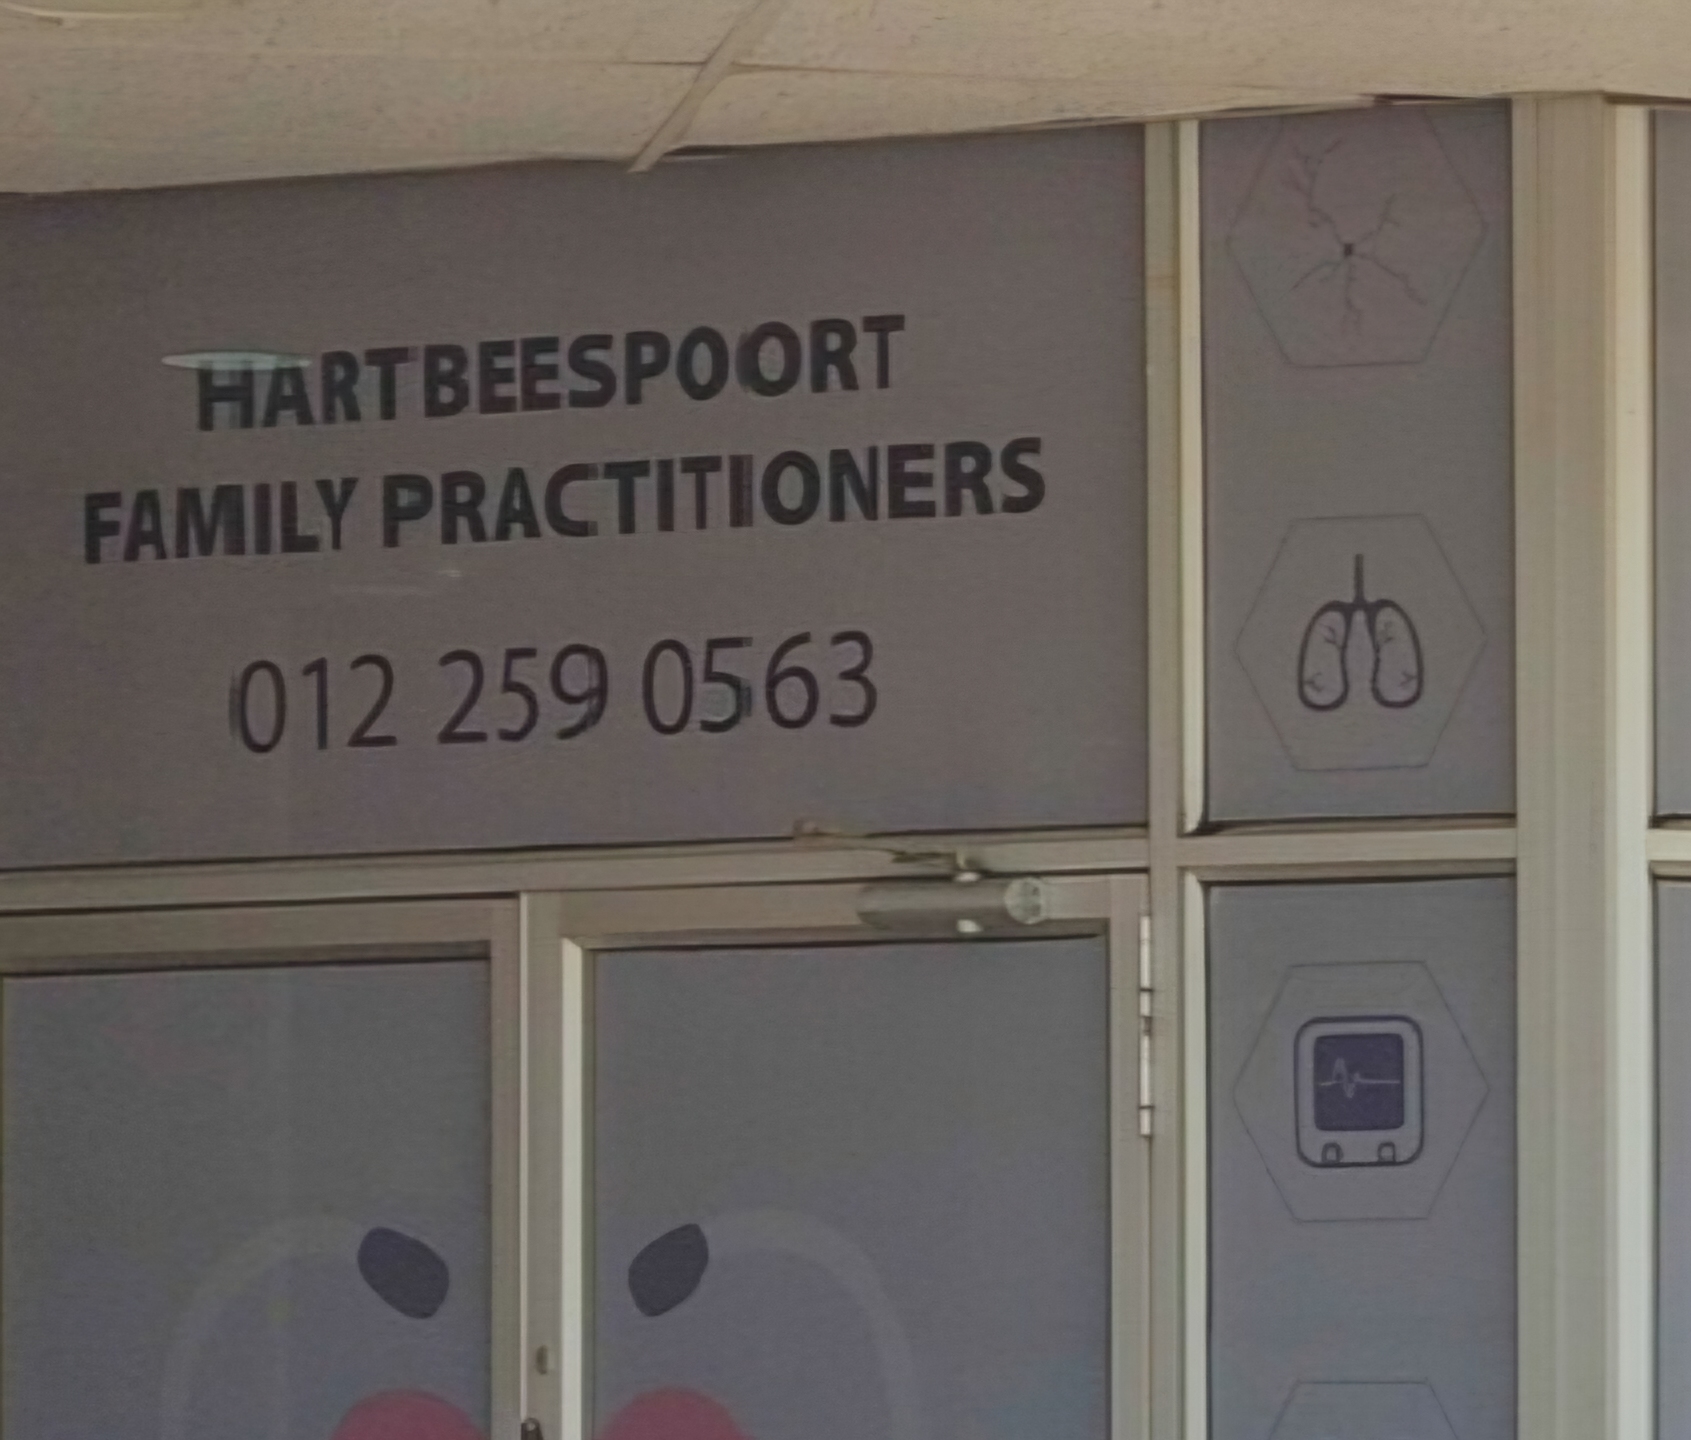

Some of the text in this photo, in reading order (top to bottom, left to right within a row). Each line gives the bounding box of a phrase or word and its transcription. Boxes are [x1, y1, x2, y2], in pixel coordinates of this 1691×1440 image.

[195, 314, 907, 434] HARTBEESPOORT
[82, 436, 1047, 566] FAMILY PRACTITIONERS
[231, 630, 879, 755] 012 259 0563
